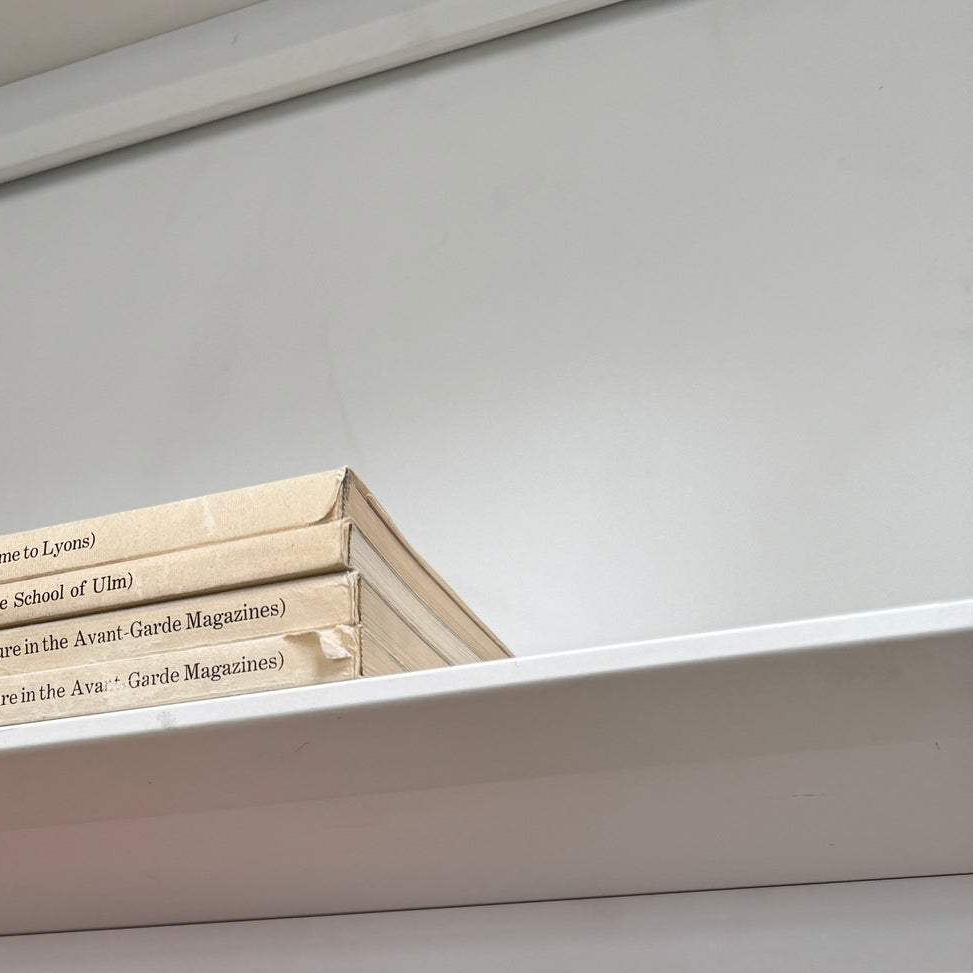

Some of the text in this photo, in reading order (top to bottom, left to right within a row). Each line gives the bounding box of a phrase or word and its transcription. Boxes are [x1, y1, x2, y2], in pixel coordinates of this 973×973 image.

[23, 546, 38, 559] to
[42, 532, 95, 558] Lyons)
[14, 584, 64, 608] School
[70, 580, 87, 597] of
[93, 572, 133, 593] Ulm)
[24, 639, 39, 655] in
[42, 634, 68, 652] the
[74, 616, 181, 647] Avant-Garde
[186, 598, 285, 630] Magazines)
[21, 687, 35, 703] in
[39, 684, 65, 700] the
[184, 651, 284, 681] Magazines)
